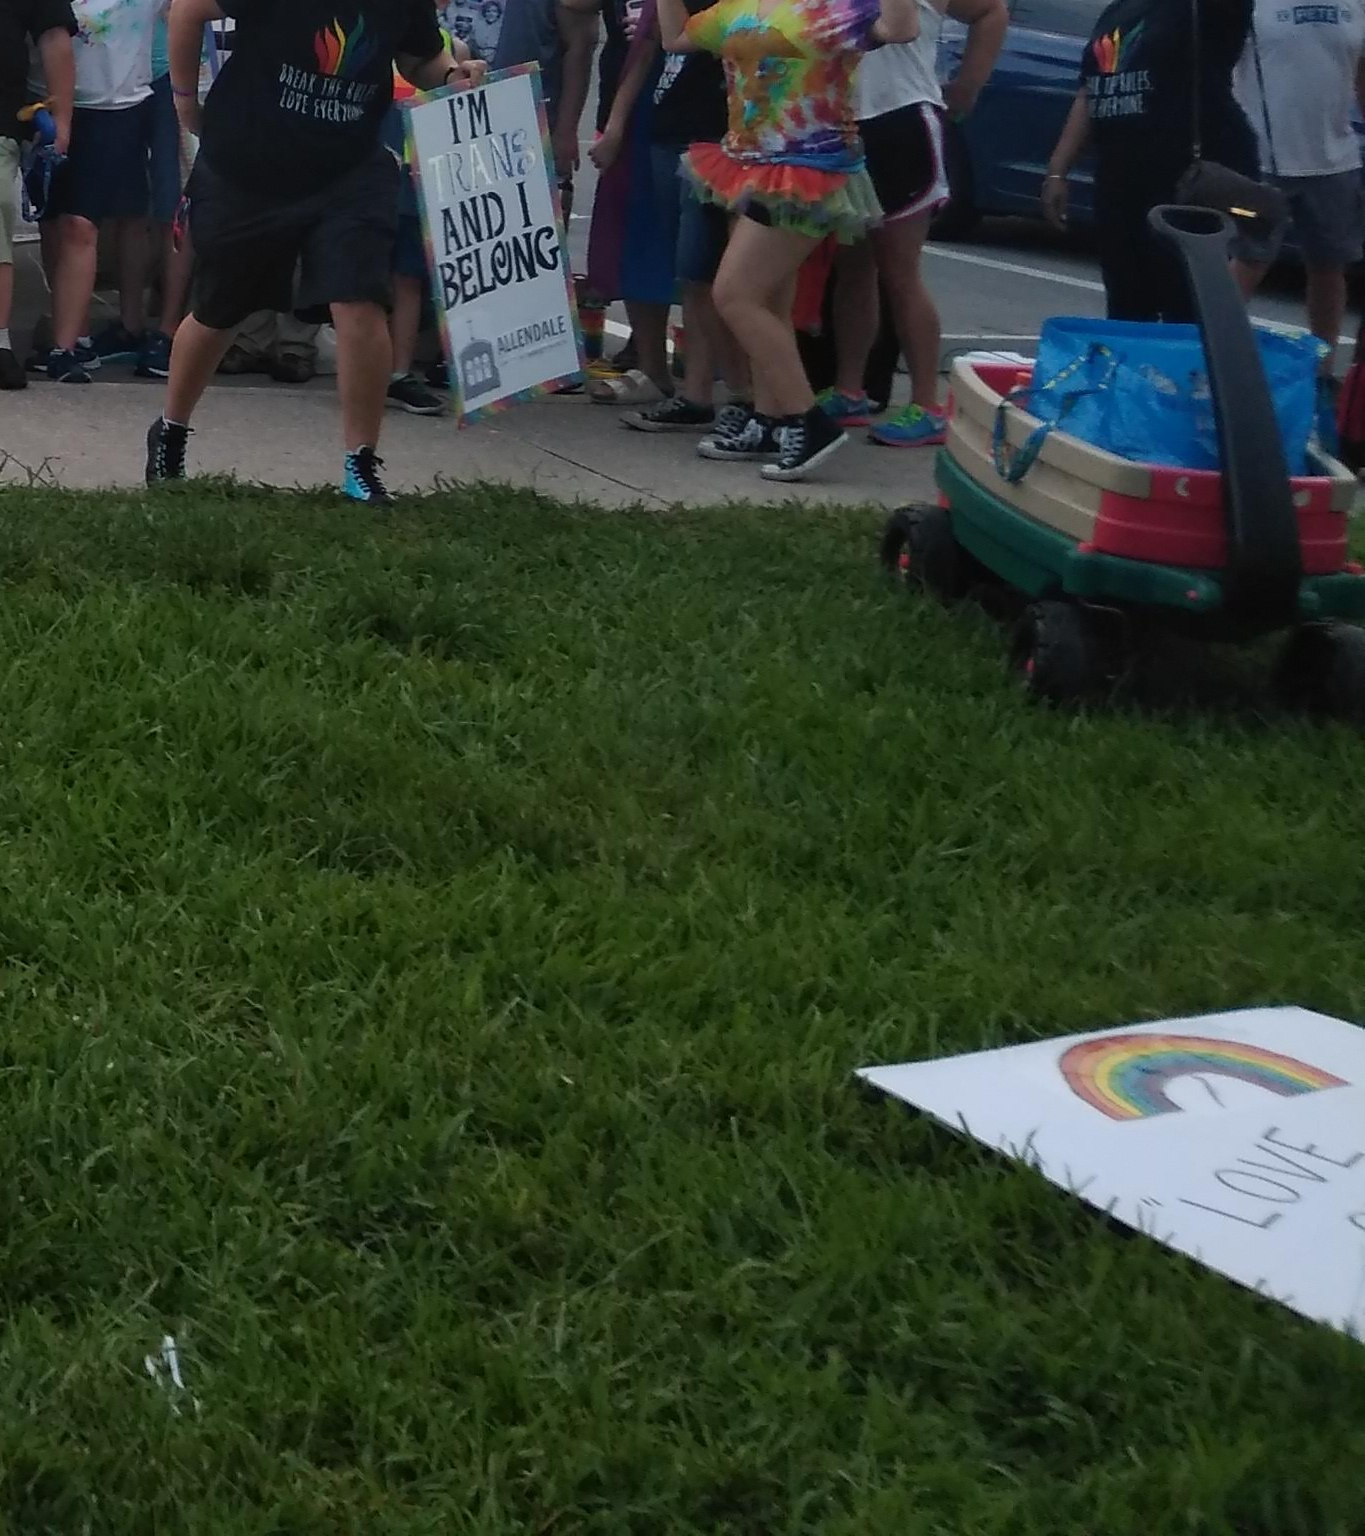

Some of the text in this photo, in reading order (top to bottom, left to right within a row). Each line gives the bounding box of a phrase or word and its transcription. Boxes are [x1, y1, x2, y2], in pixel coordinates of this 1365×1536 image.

[279, 63, 317, 93] BREAK
[321, 78, 344, 97] THE
[280, 86, 308, 114] LOVE
[428, 128, 537, 202] TRANS
[441, 181, 533, 256] AND I
[438, 225, 562, 311] BELONG
[496, 315, 567, 355] ALLENDALE
